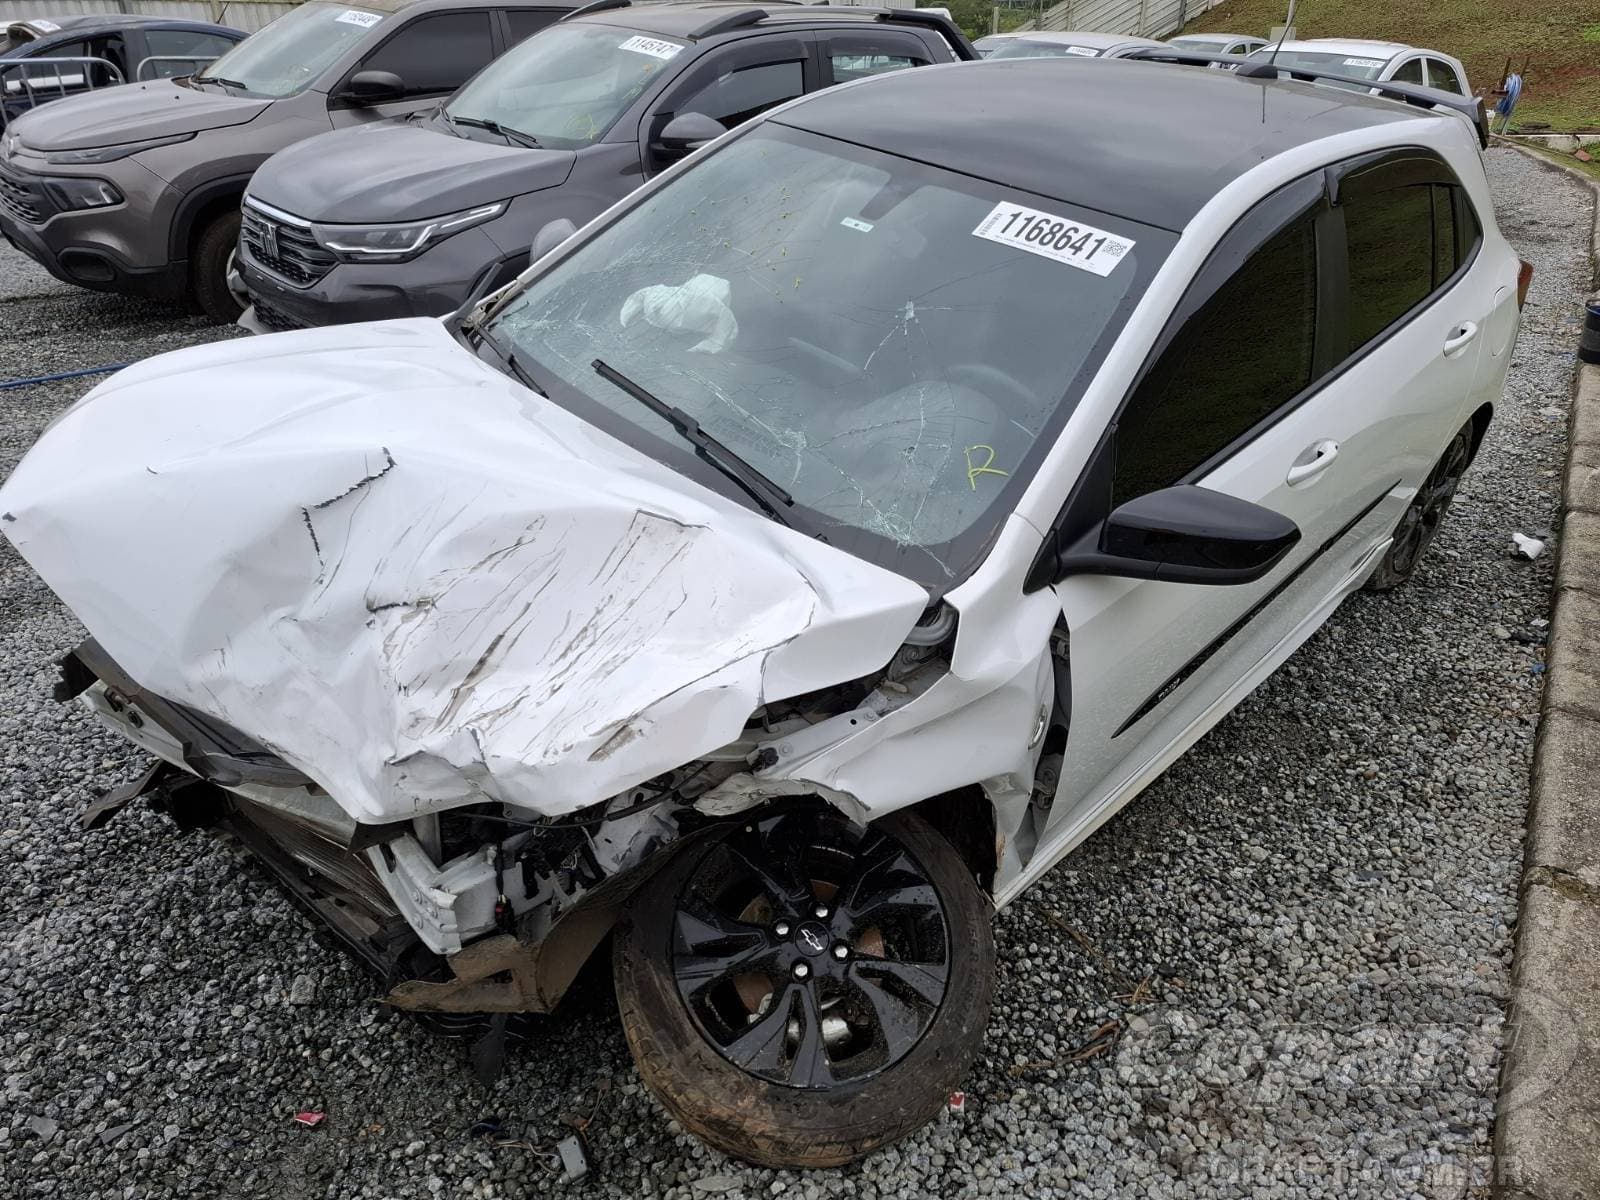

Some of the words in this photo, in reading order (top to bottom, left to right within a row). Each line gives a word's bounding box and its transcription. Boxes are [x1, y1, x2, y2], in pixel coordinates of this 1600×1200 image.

[630, 38, 675, 55] 1145747
[1000, 211, 1107, 260] 1168641
[963, 445, 1009, 491] R
